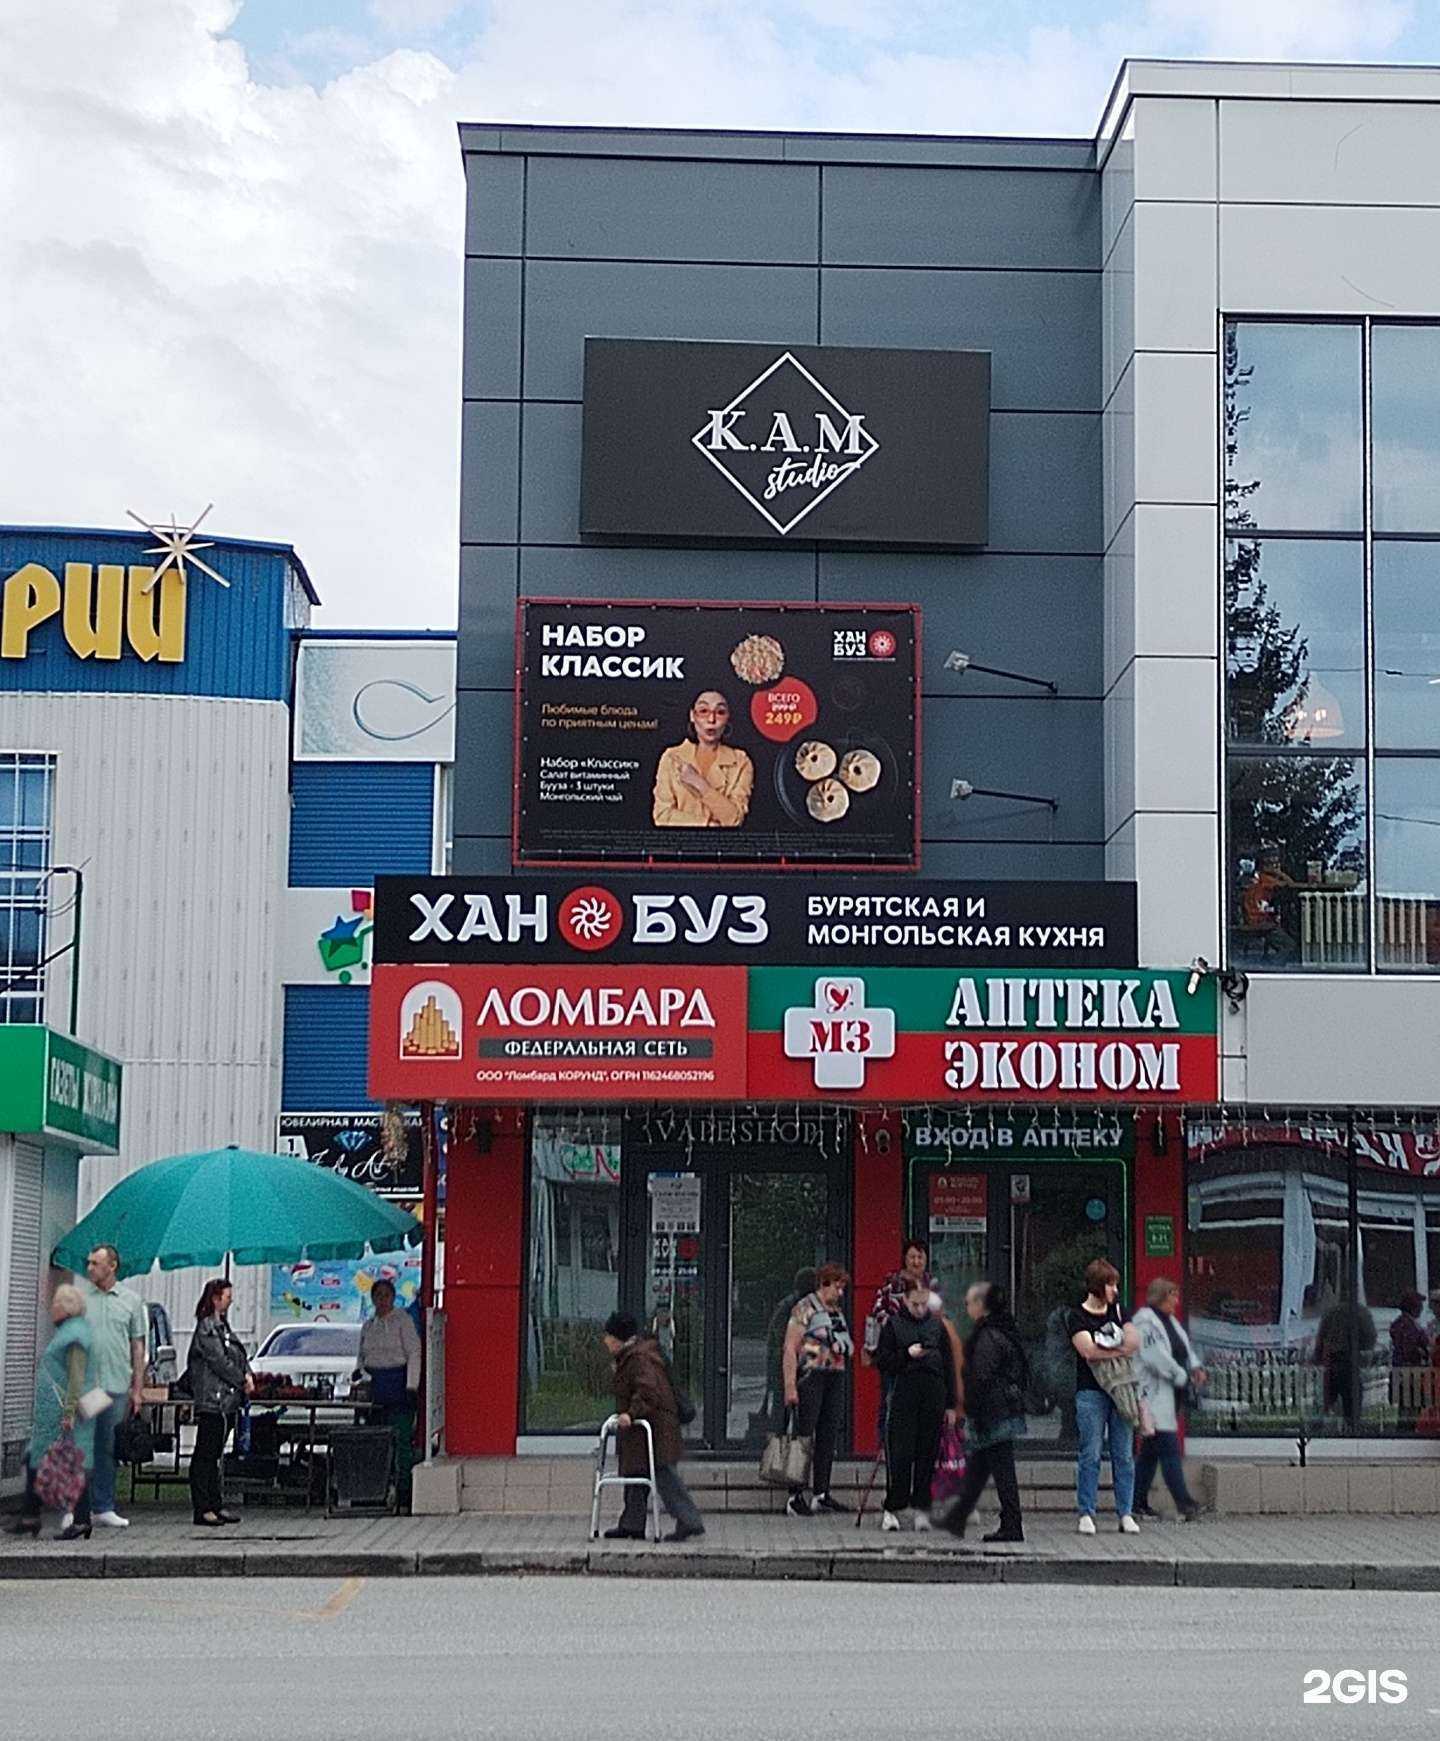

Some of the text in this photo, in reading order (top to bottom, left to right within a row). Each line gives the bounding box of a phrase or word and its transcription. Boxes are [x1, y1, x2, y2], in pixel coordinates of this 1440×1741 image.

[707, 410, 866, 454] K.A.M
[763, 453, 862, 500] studio
[542, 625, 645, 648] НАБОР
[833, 631, 866, 643] ХАН
[833, 643, 866, 656] БУЗ
[542, 655, 685, 679] КЛАССИК
[768, 692, 800, 703] ВСЕГО
[542, 703, 638, 716] Любимые блюда
[541, 719, 557, 728] по
[559, 719, 617, 730] приятным
[540, 757, 639, 769] Набор «Классик»
[540, 769, 568, 779] Салат
[583, 783, 614, 793] штуки
[540, 792, 623, 801] Монгольский чай
[808, 896, 985, 918] БУРЯТСКАЯ И
[409, 893, 769, 944] ХАН БУЗ
[808, 924, 1104, 947] МОНГОЛЬСКАЯ КУХНЯ
[476, 987, 716, 1028] ЛОМБАРД
[945, 977, 1180, 1028] АПТЕКА
[504, 1040, 688, 1056] ФЕДЕРАЛЬНАЯ СЕТЬ
[944, 1041, 1181, 1091] ЭКОНОМ
[476, 1070, 503, 1081] ООО
[611, 1071, 640, 1081] ОГРН
[281, 1117, 349, 1128] ЮВЕЛИРНАЯ
[915, 1127, 1124, 1149] ВХОД В АПТЕКУ
